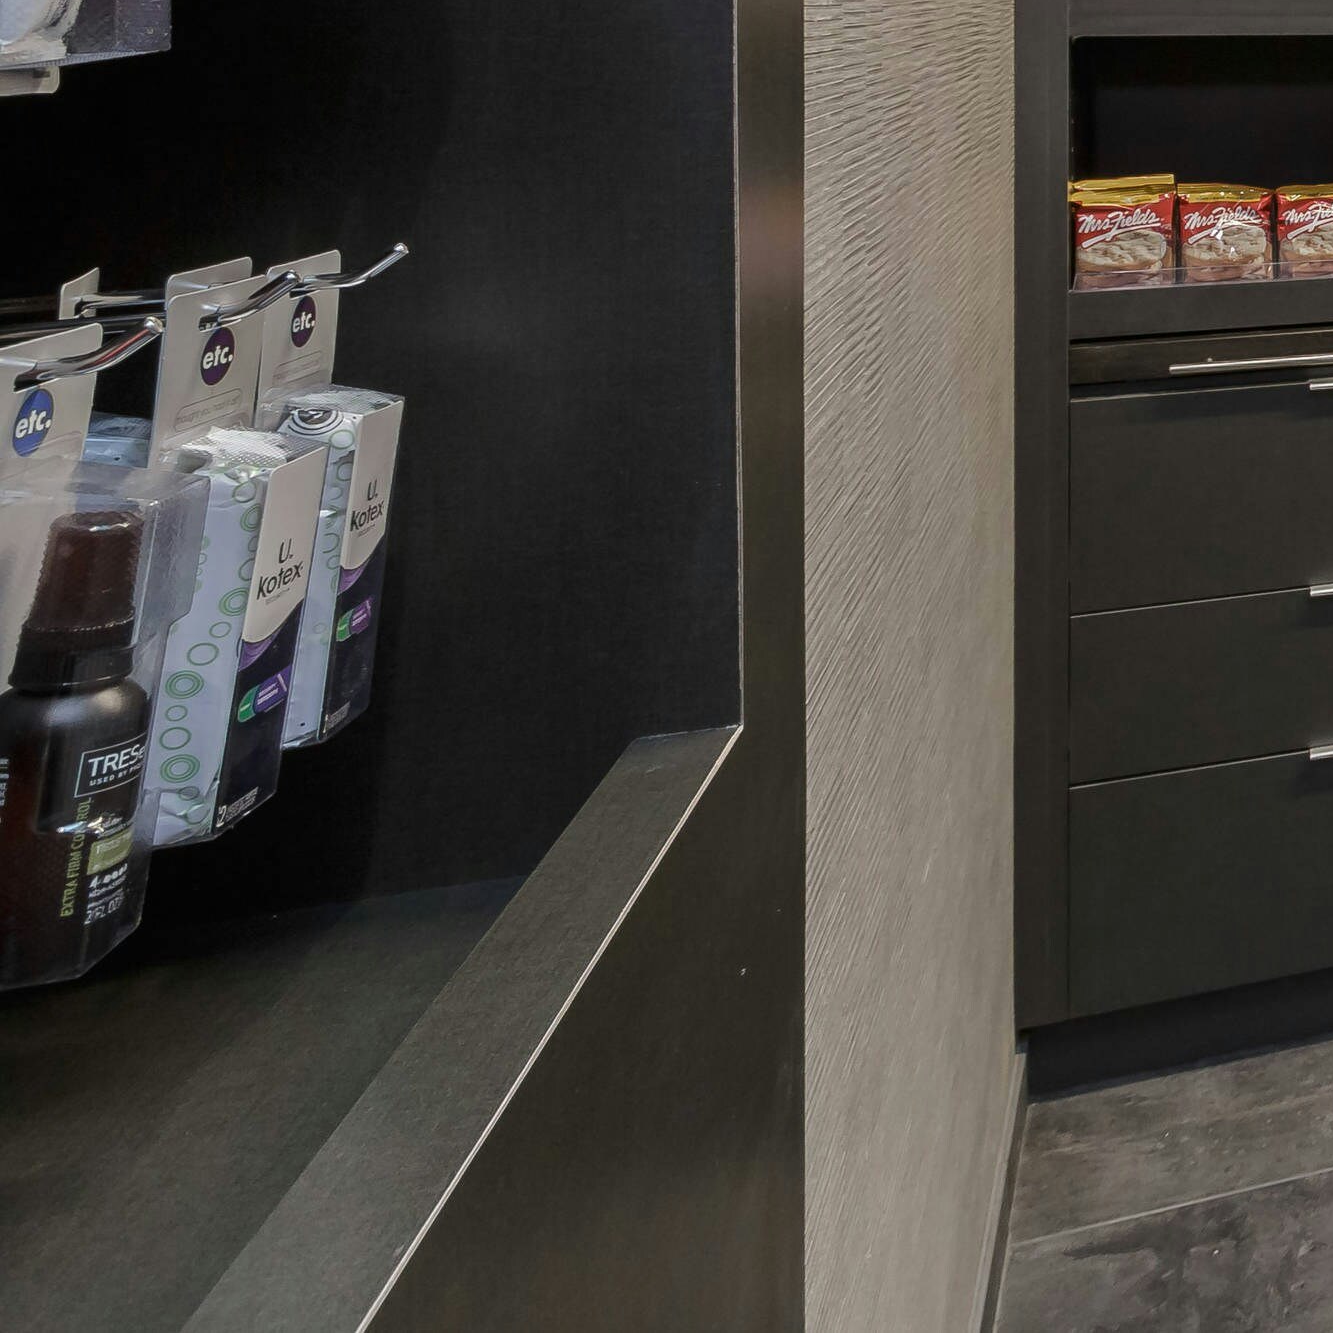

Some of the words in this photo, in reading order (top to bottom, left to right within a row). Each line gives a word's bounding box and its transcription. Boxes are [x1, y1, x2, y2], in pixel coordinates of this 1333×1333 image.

[291, 308, 317, 333] etc.
[203, 345, 234, 370] etc.
[15, 409, 52, 439] etc.
[89, 774, 115, 787] USED
